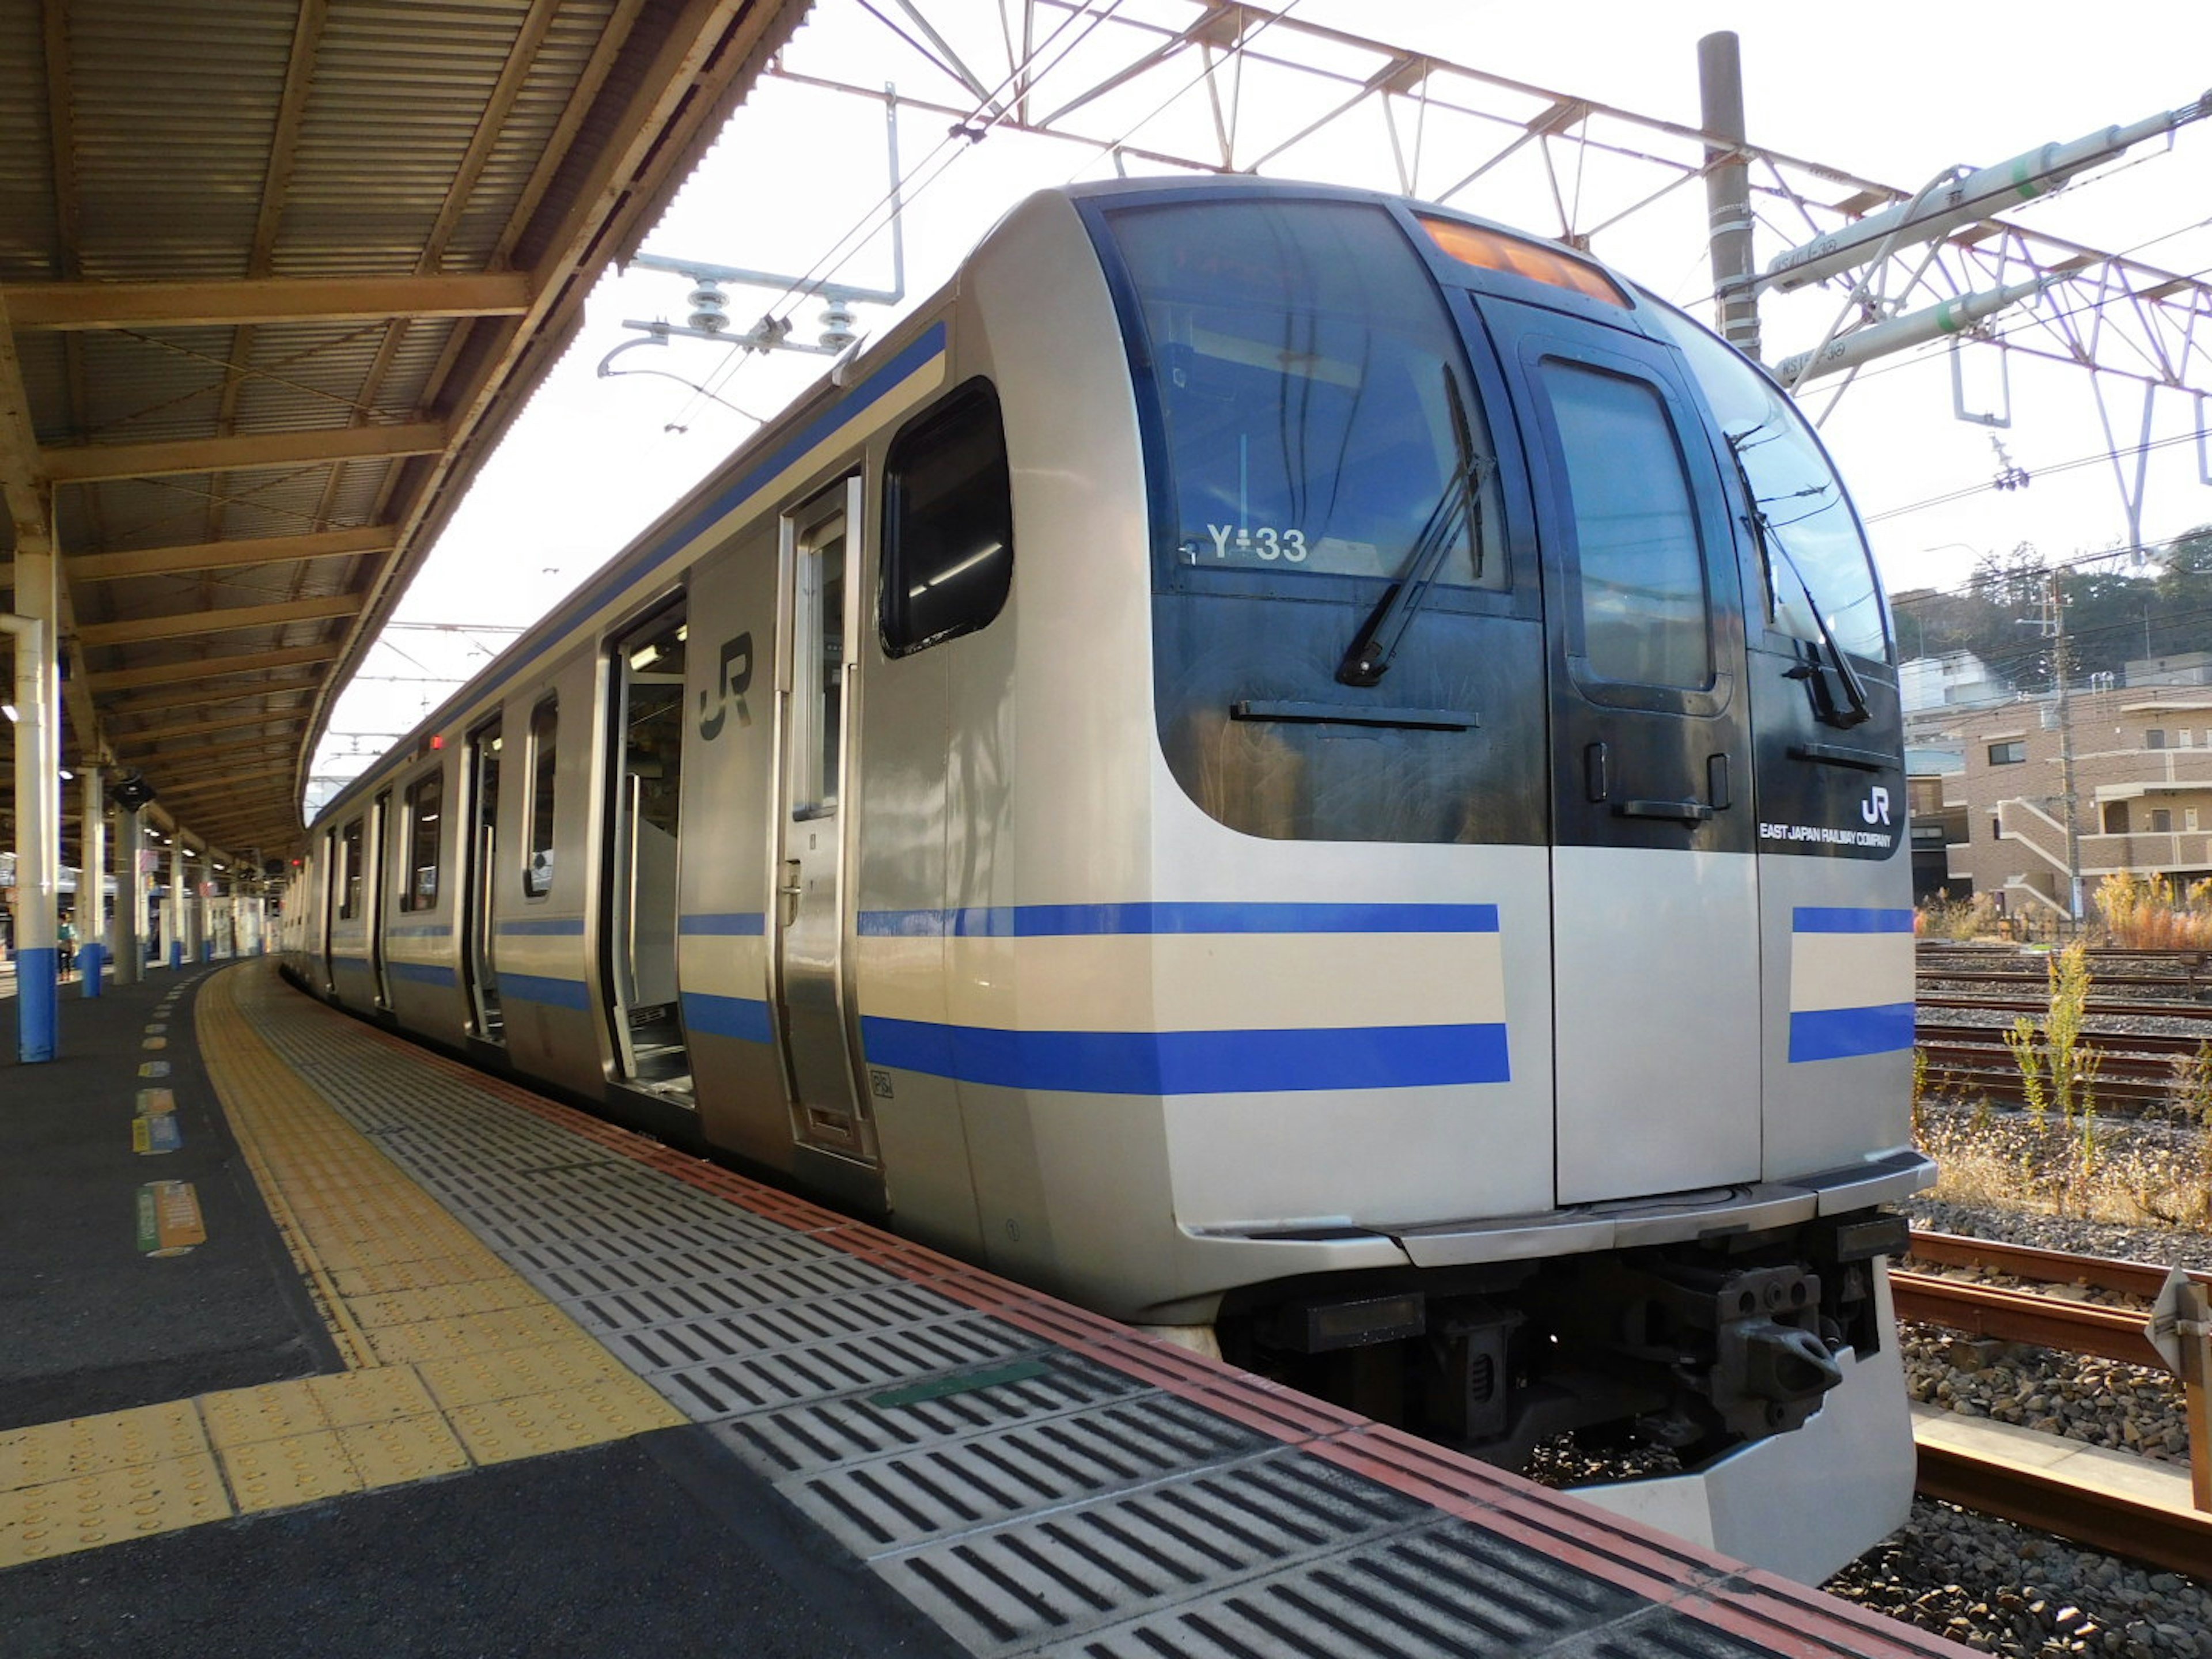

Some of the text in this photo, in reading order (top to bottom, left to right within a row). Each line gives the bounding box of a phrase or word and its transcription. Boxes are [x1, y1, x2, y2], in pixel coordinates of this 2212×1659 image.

[1207, 524, 1307, 562] Y-33
[700, 632, 752, 740] JR
[1861, 786, 1891, 826] JR
[1759, 822, 1891, 847] EAST JAPAN RAILWAY COMPANY
